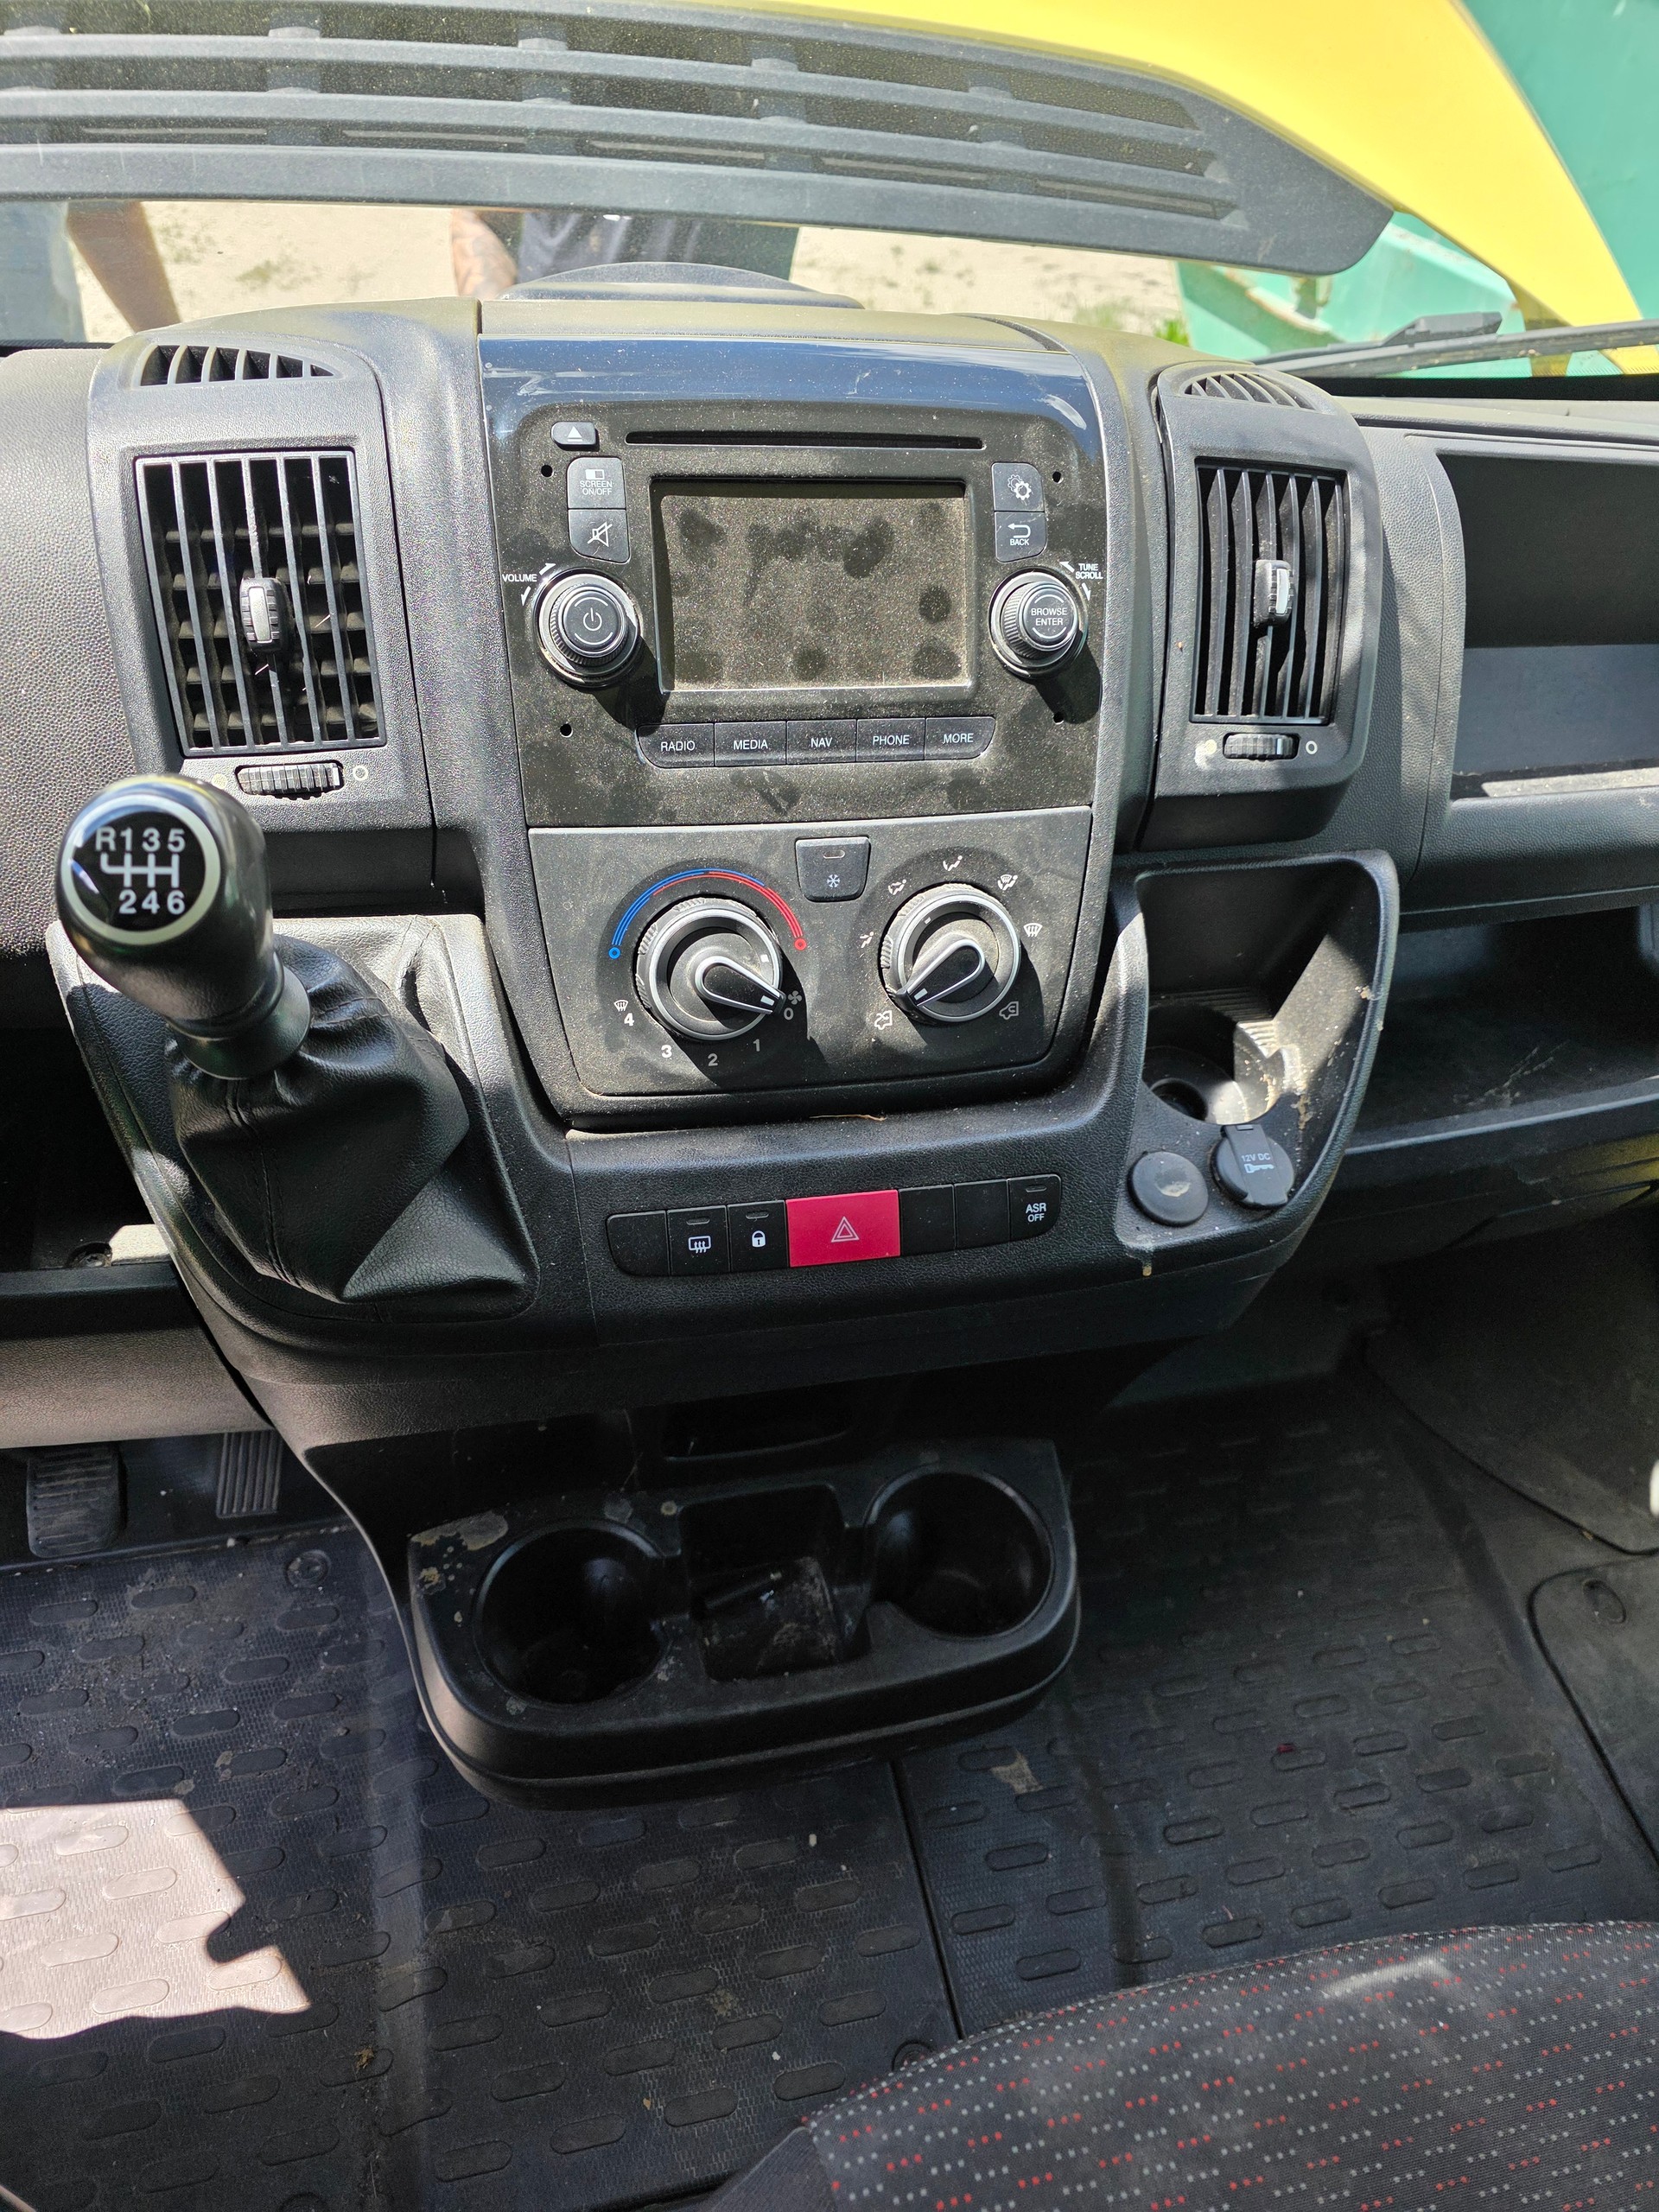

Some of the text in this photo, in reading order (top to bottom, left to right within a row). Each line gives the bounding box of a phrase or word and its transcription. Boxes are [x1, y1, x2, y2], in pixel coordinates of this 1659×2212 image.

[579, 480, 613, 488] SCREEN
[502, 573, 537, 582] VOLUME
[1075, 571, 1103, 580] SCROLL
[1031, 607, 1068, 616] BROWSE
[1035, 618, 1064, 626] ENTER
[810, 737, 833, 748] NAV
[872, 734, 910, 746] PHONE
[943, 733, 974, 744] MORE
[660, 740, 696, 752] RADIO
[733, 739, 769, 751] MEDIA
[783, 1007, 794, 1020] 0
[624, 1012, 635, 1027] 4
[661, 1044, 672, 1058] 3
[753, 1039, 761, 1052] 1
[708, 1052, 719, 1067] 2
[1242, 1154, 1256, 1162] 12V
[1026, 1203, 1046, 1213] ASR
[1027, 1213, 1045, 1222] OFF
